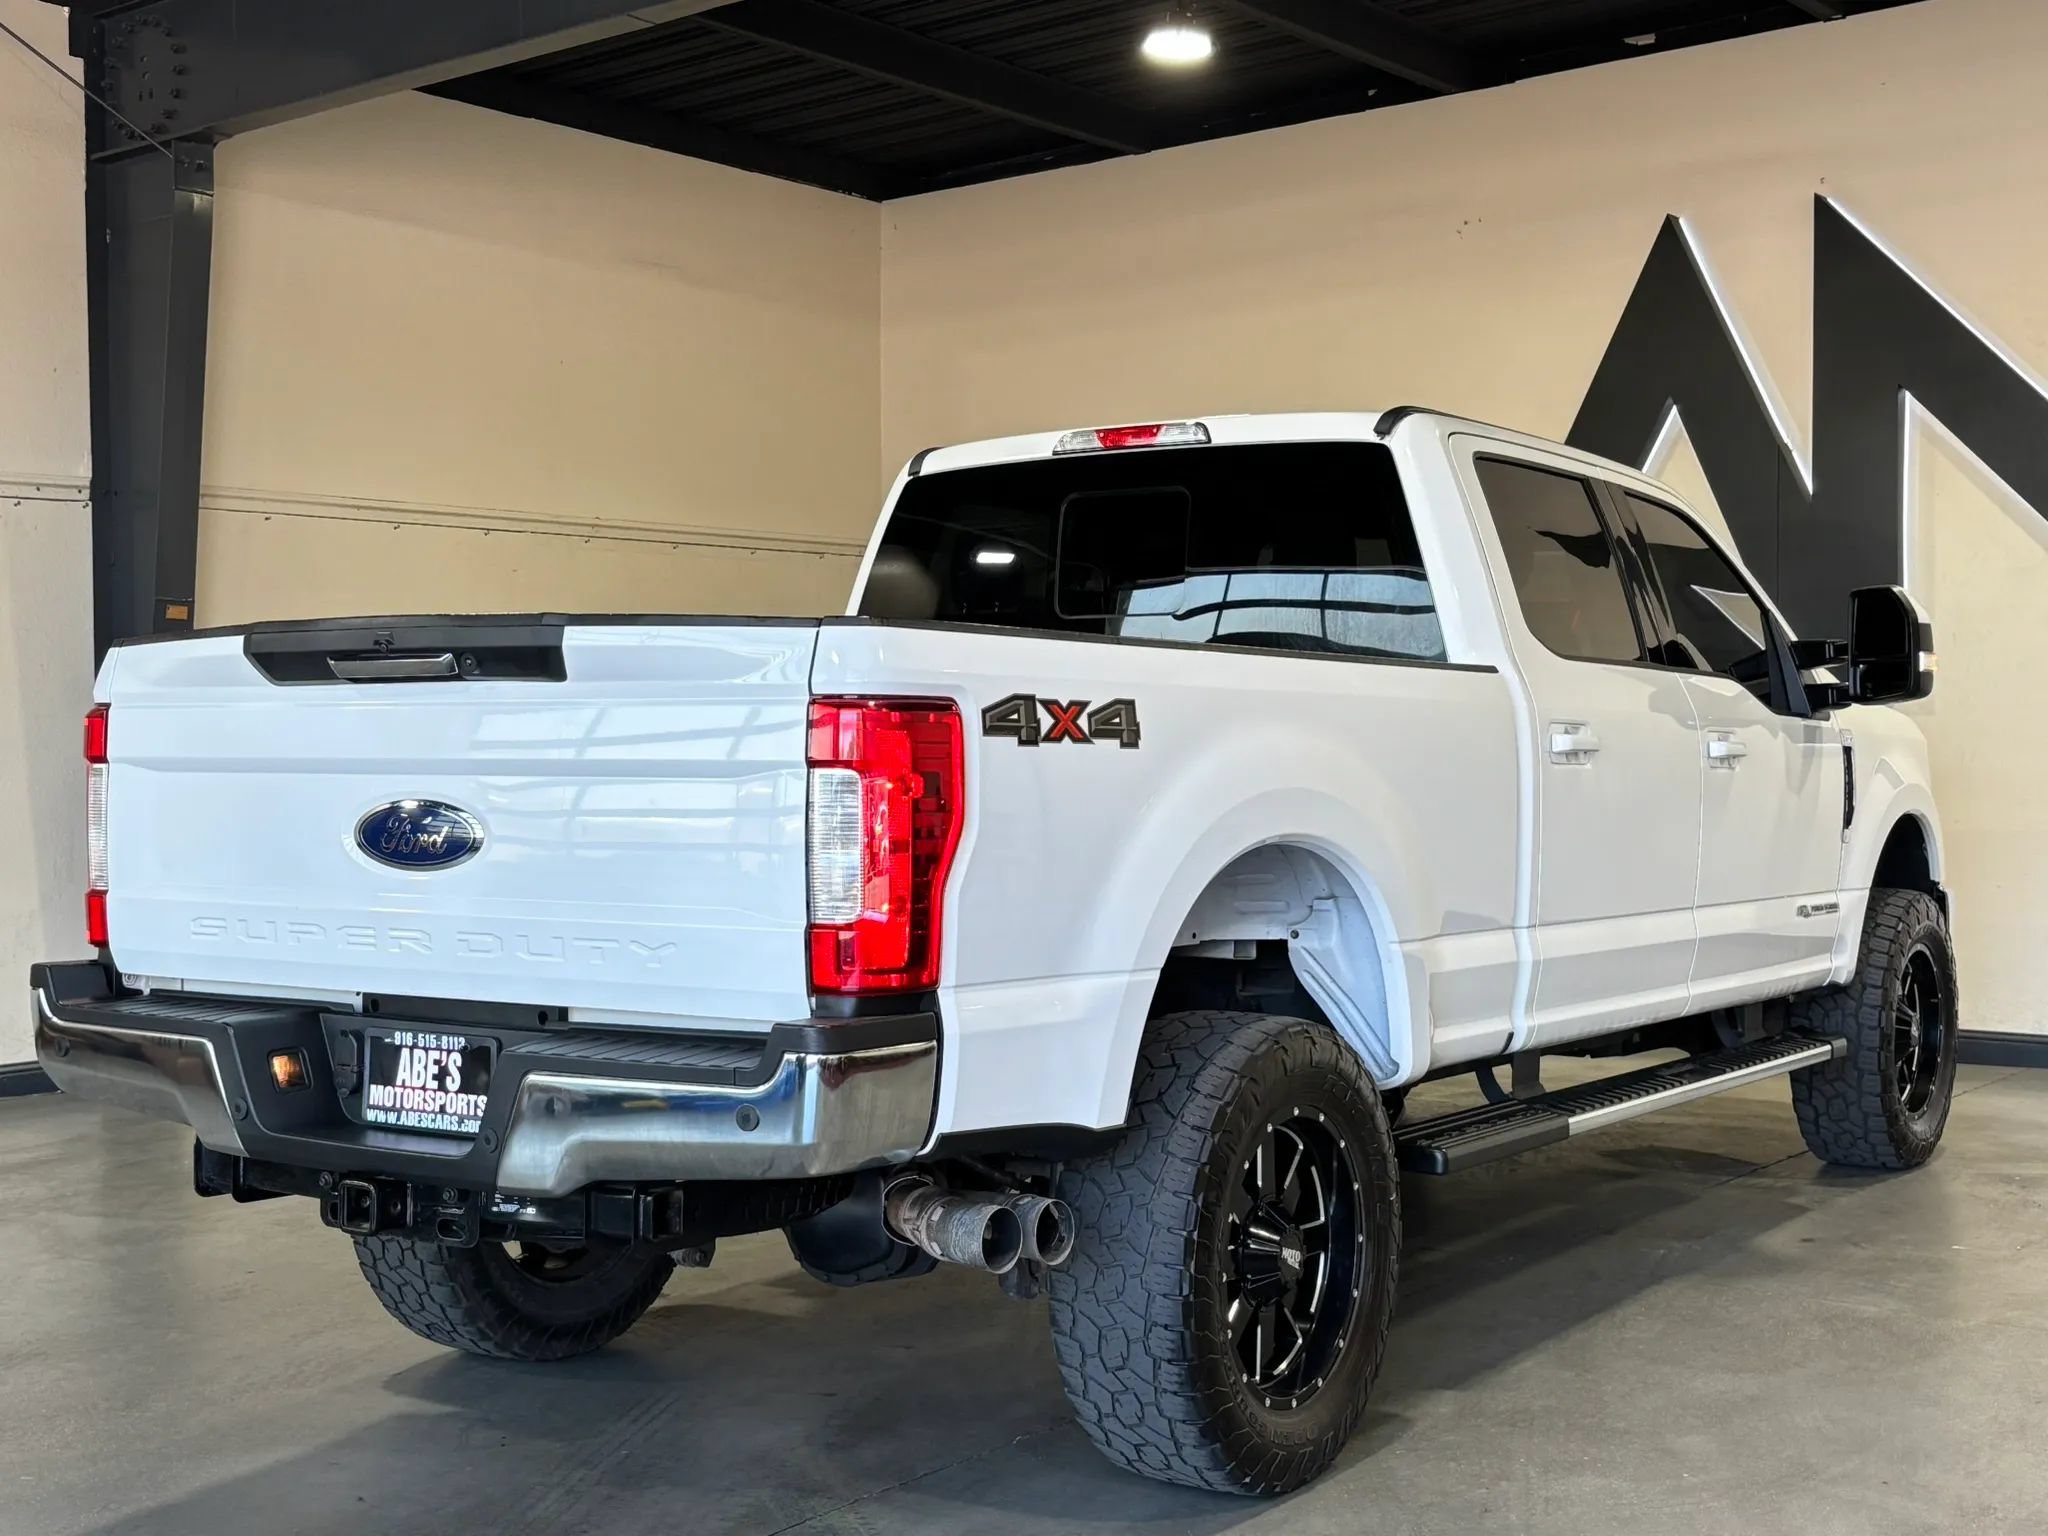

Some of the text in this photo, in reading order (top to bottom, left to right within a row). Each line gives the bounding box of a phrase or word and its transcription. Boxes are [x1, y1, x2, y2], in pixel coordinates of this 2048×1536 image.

[380, 813, 449, 855] Ford
[189, 915, 678, 969] SUPER DUTY
[395, 1047, 463, 1092] ABE'S
[368, 1084, 488, 1117] MOTORSPORTS
